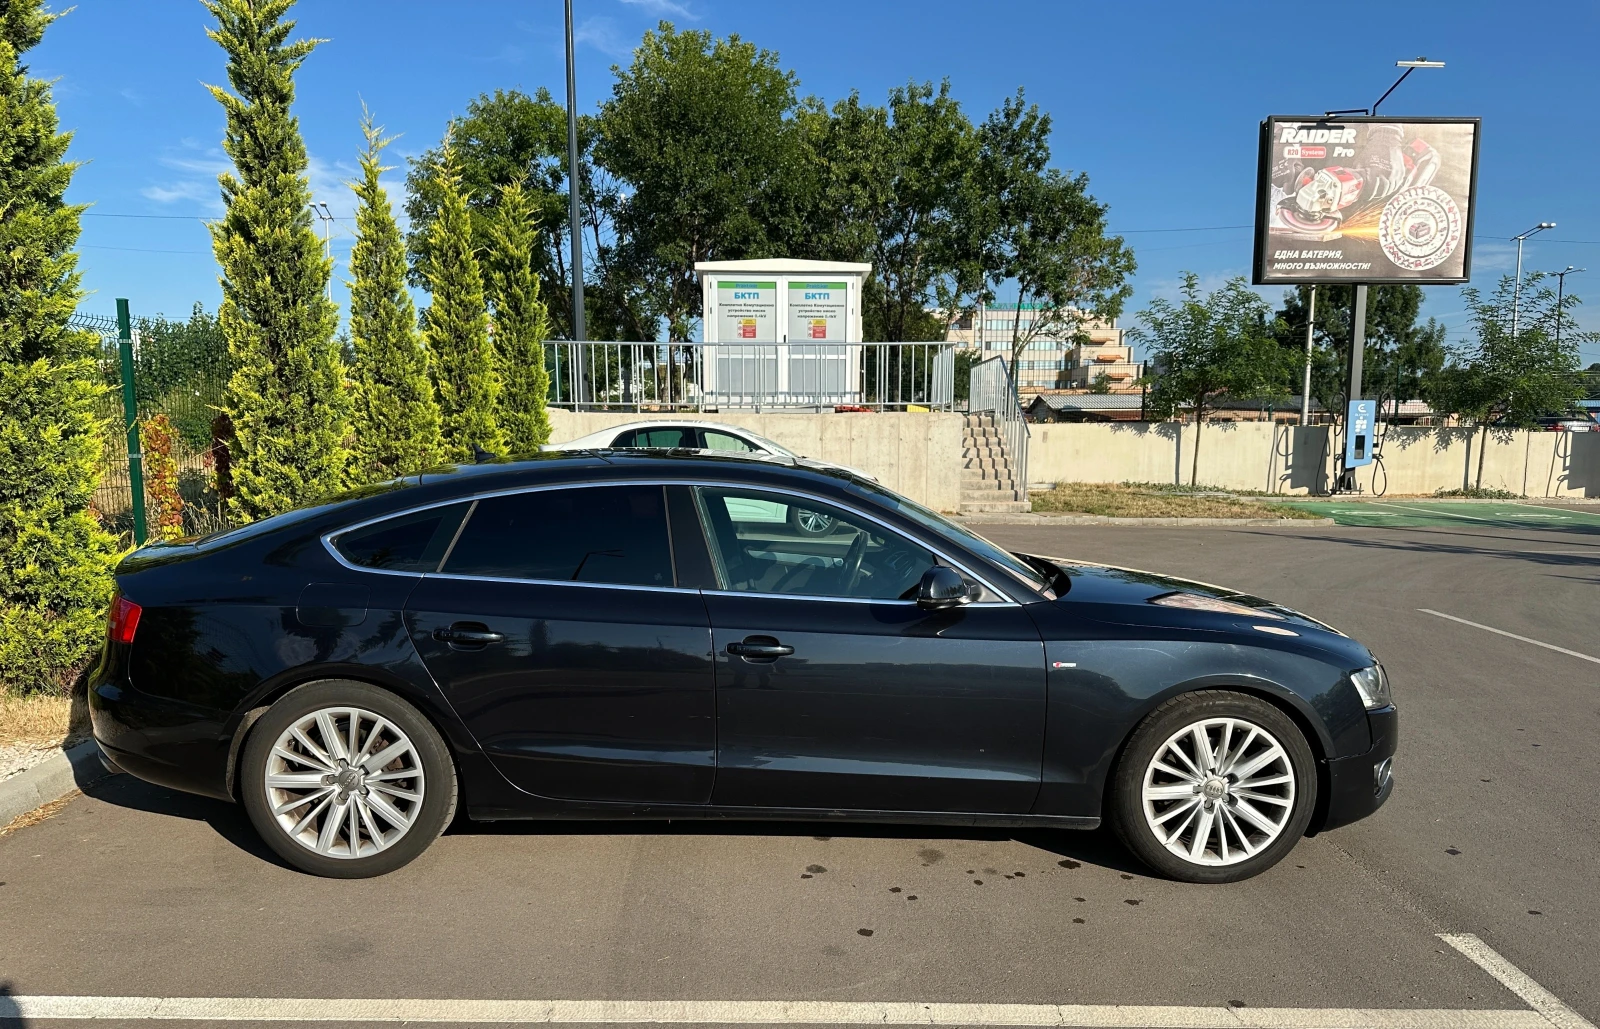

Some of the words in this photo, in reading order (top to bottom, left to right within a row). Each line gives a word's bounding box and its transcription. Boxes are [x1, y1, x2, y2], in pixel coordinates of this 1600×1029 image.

[1280, 128, 1357, 143] RAIDER
[1333, 146, 1355, 157] Pro
[1274, 250, 1299, 259] ЕДНА
[1300, 250, 1344, 260] БАТЕРИЯ,
[1273, 262, 1303, 270] МНОГО
[1303, 262, 1371, 270] ВЪЗМОЖНОСТИ!
[734, 292, 760, 300] БКТП
